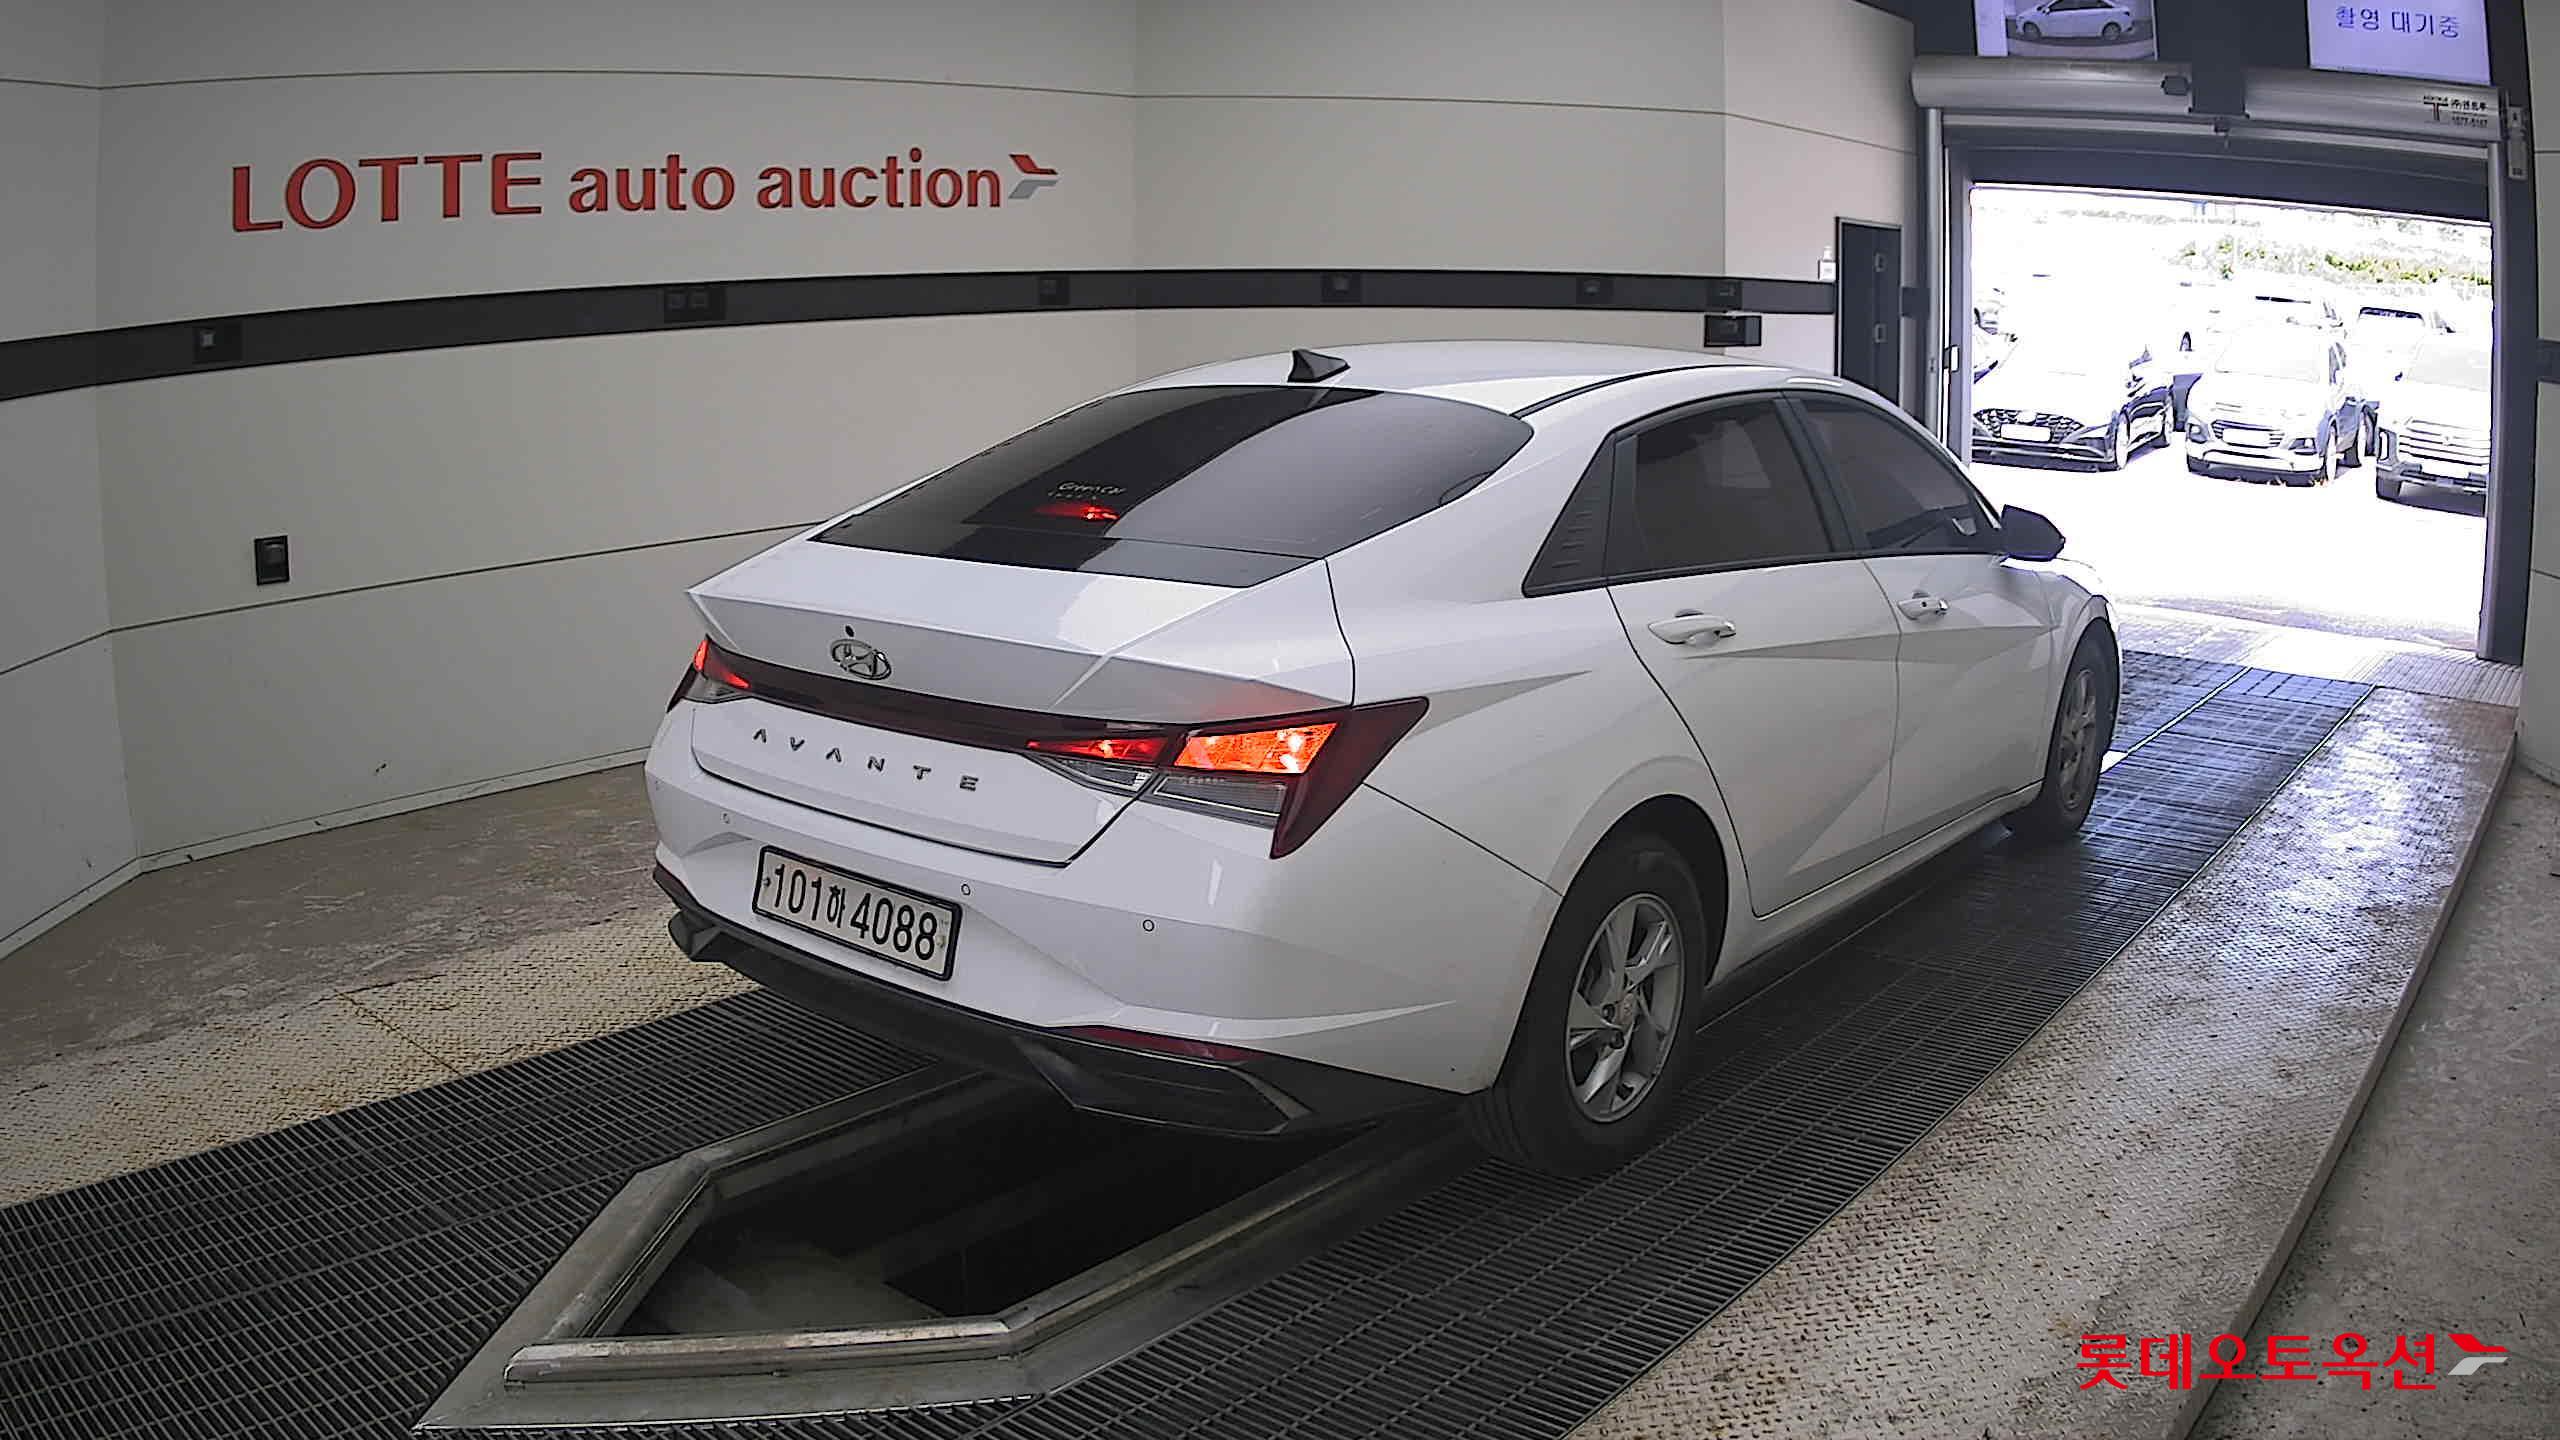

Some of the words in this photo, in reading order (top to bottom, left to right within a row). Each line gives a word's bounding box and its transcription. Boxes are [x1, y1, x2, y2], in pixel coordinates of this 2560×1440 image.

[2391, 11, 2459, 38] 대기중
[232, 151, 542, 233] LOTTE
[568, 153, 735, 213] auto
[756, 147, 1001, 209] auction
[753, 728, 979, 791] AVANTE
